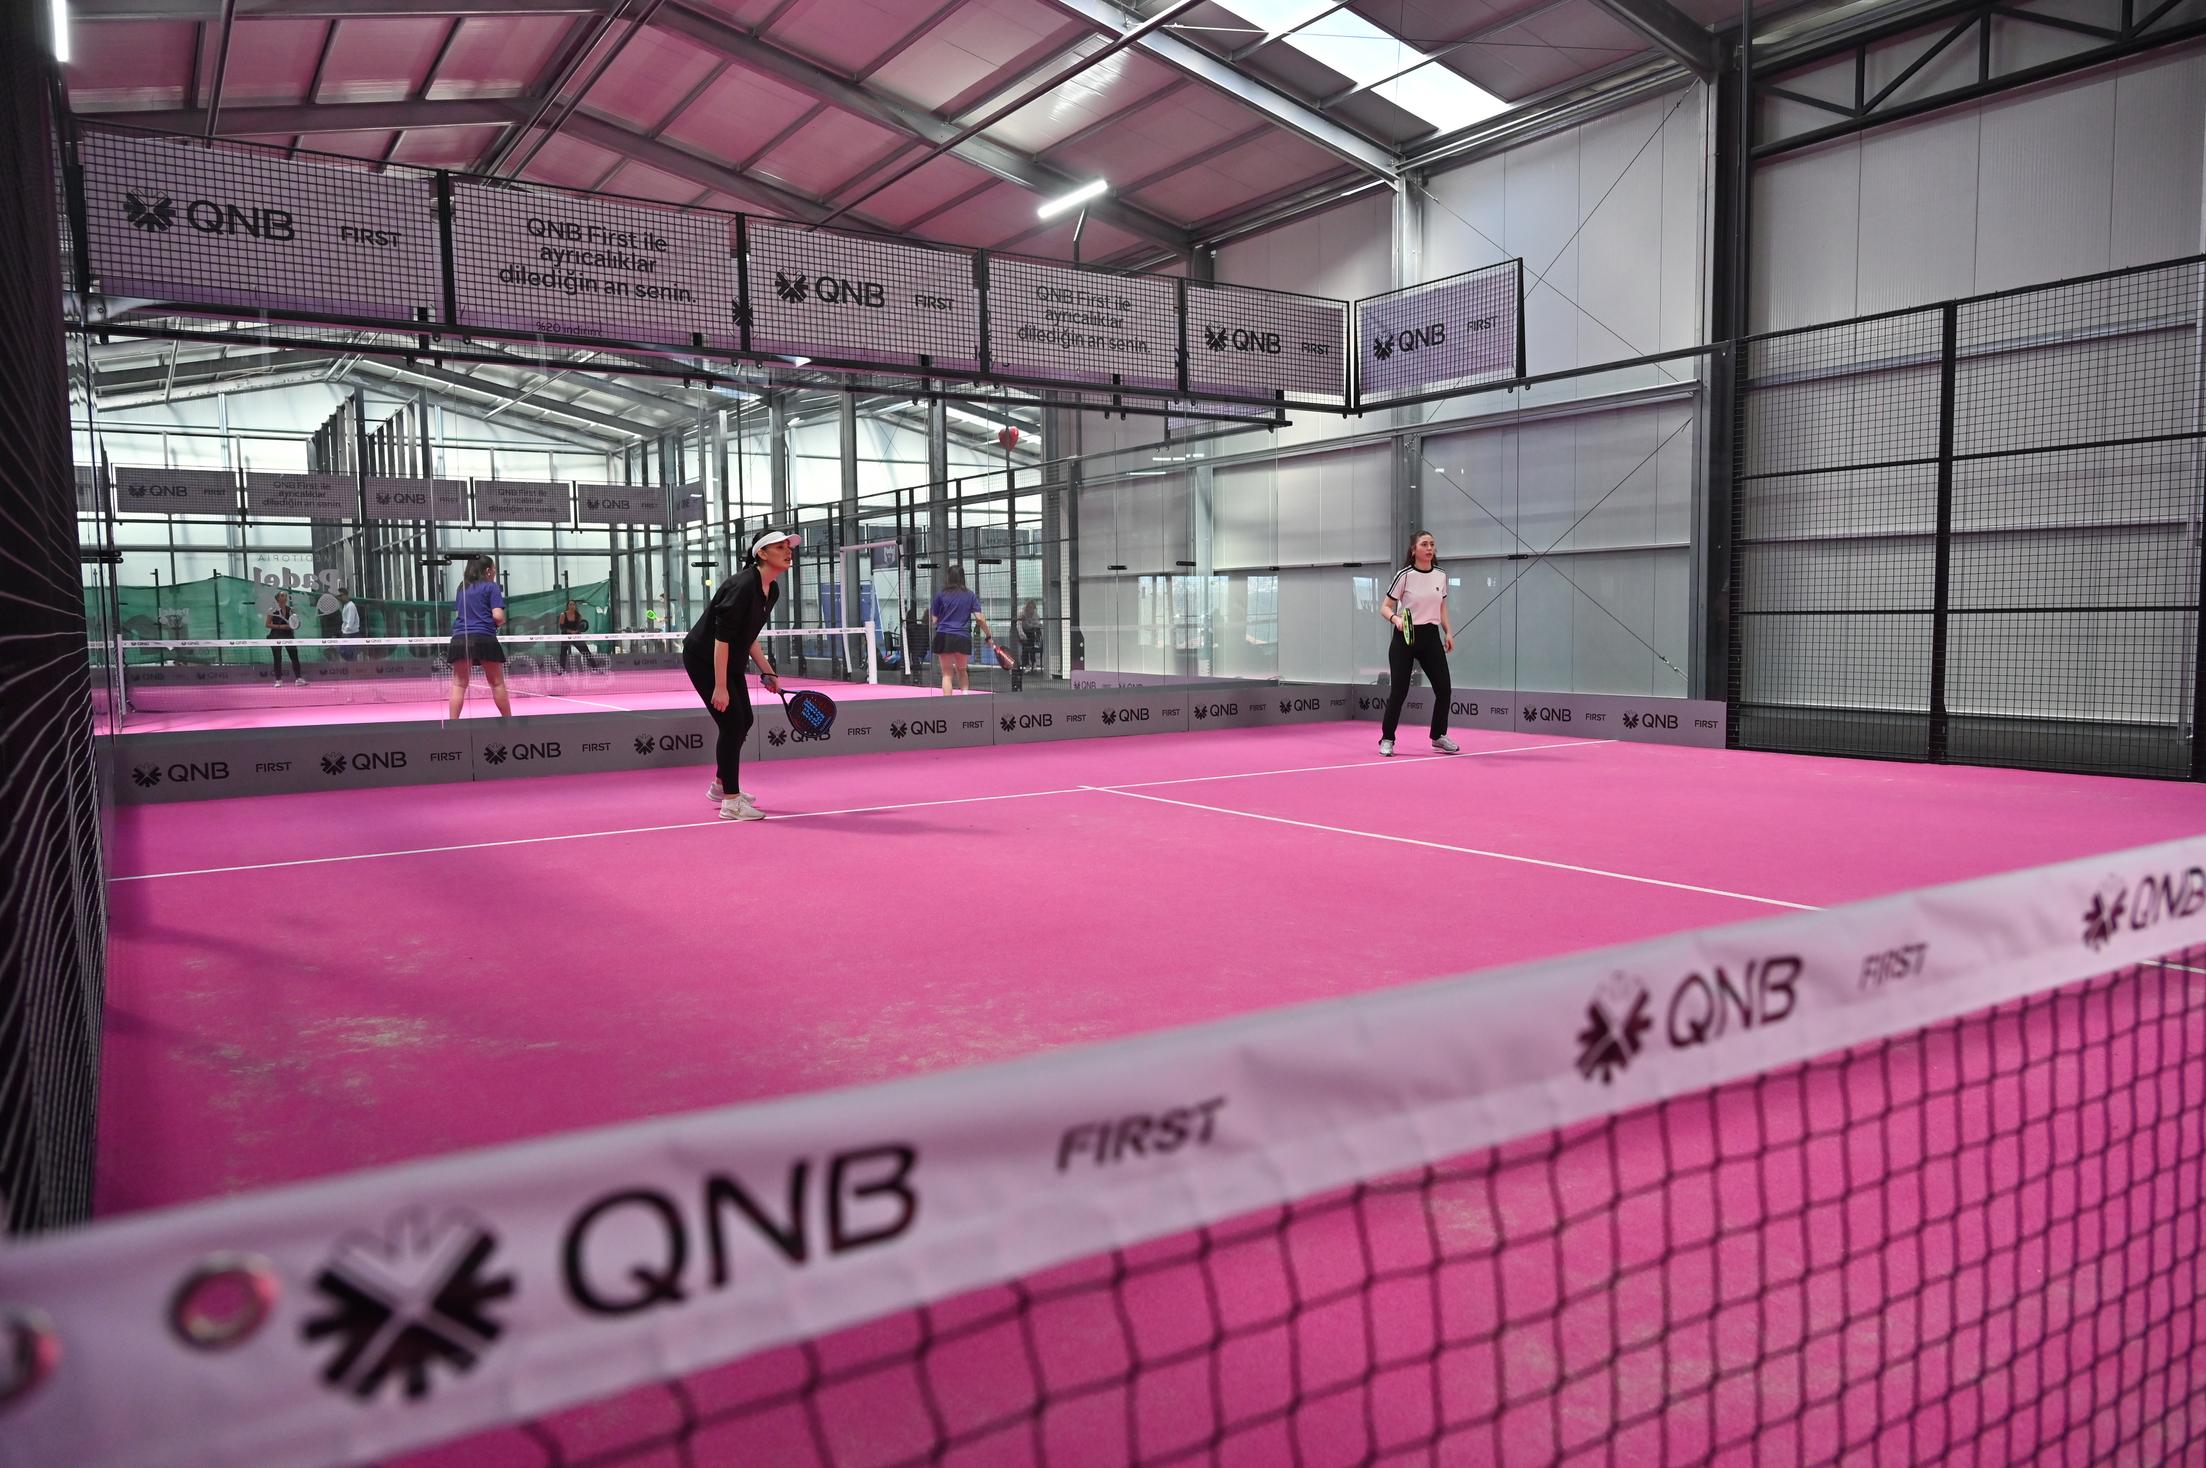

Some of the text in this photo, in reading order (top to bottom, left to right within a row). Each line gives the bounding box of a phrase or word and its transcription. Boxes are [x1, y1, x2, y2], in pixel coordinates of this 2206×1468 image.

[187, 200, 401, 247] QNB FIRST
[527, 218, 667, 252] QNB First ile
[540, 246, 657, 273] ayrıcalıklar
[500, 265, 697, 303] dilediğin an senin.
[815, 276, 955, 311] QNB FIRST
[1036, 286, 1132, 311] QNB First ile
[1018, 324, 1084, 349] dilediğin
[1088, 335, 1105, 349] an
[1231, 328, 1330, 356] QNB FIRST
[1399, 315, 1498, 352] QNB FIRST
[149, 485, 188, 497] QNB
[393, 493, 426, 505] QNB
[602, 499, 630, 509] QNB
[1372, 697, 1719, 730] QN FIRST QNB FIRST QNB FIRST QNB FIRST
[167, 762, 229, 782] QNB
[256, 761, 292, 774] FIRST
[352, 751, 407, 771] QNB
[430, 751, 462, 761] FIRST
[512, 742, 561, 761] QNB
[582, 742, 611, 752] FIRST
[659, 734, 703, 751] QNB
[848, 727, 872, 736] FIRST
[910, 720, 947, 735] QNB
[962, 720, 984, 729] FIRST
[1019, 714, 1053, 729] QNB
[1066, 714, 1086, 723] FIRST
[1119, 708, 1149, 722] QNB
[1162, 708, 1180, 717] FIRST
[1209, 704, 1238, 717] QNB
[1250, 704, 1266, 712] FIRST
[1293, 699, 1320, 711] QNB
[1330, 699, 1345, 707] FIRST
[559, 866, 2206, 1318] QNB FIRST QNB FIRST QNB
